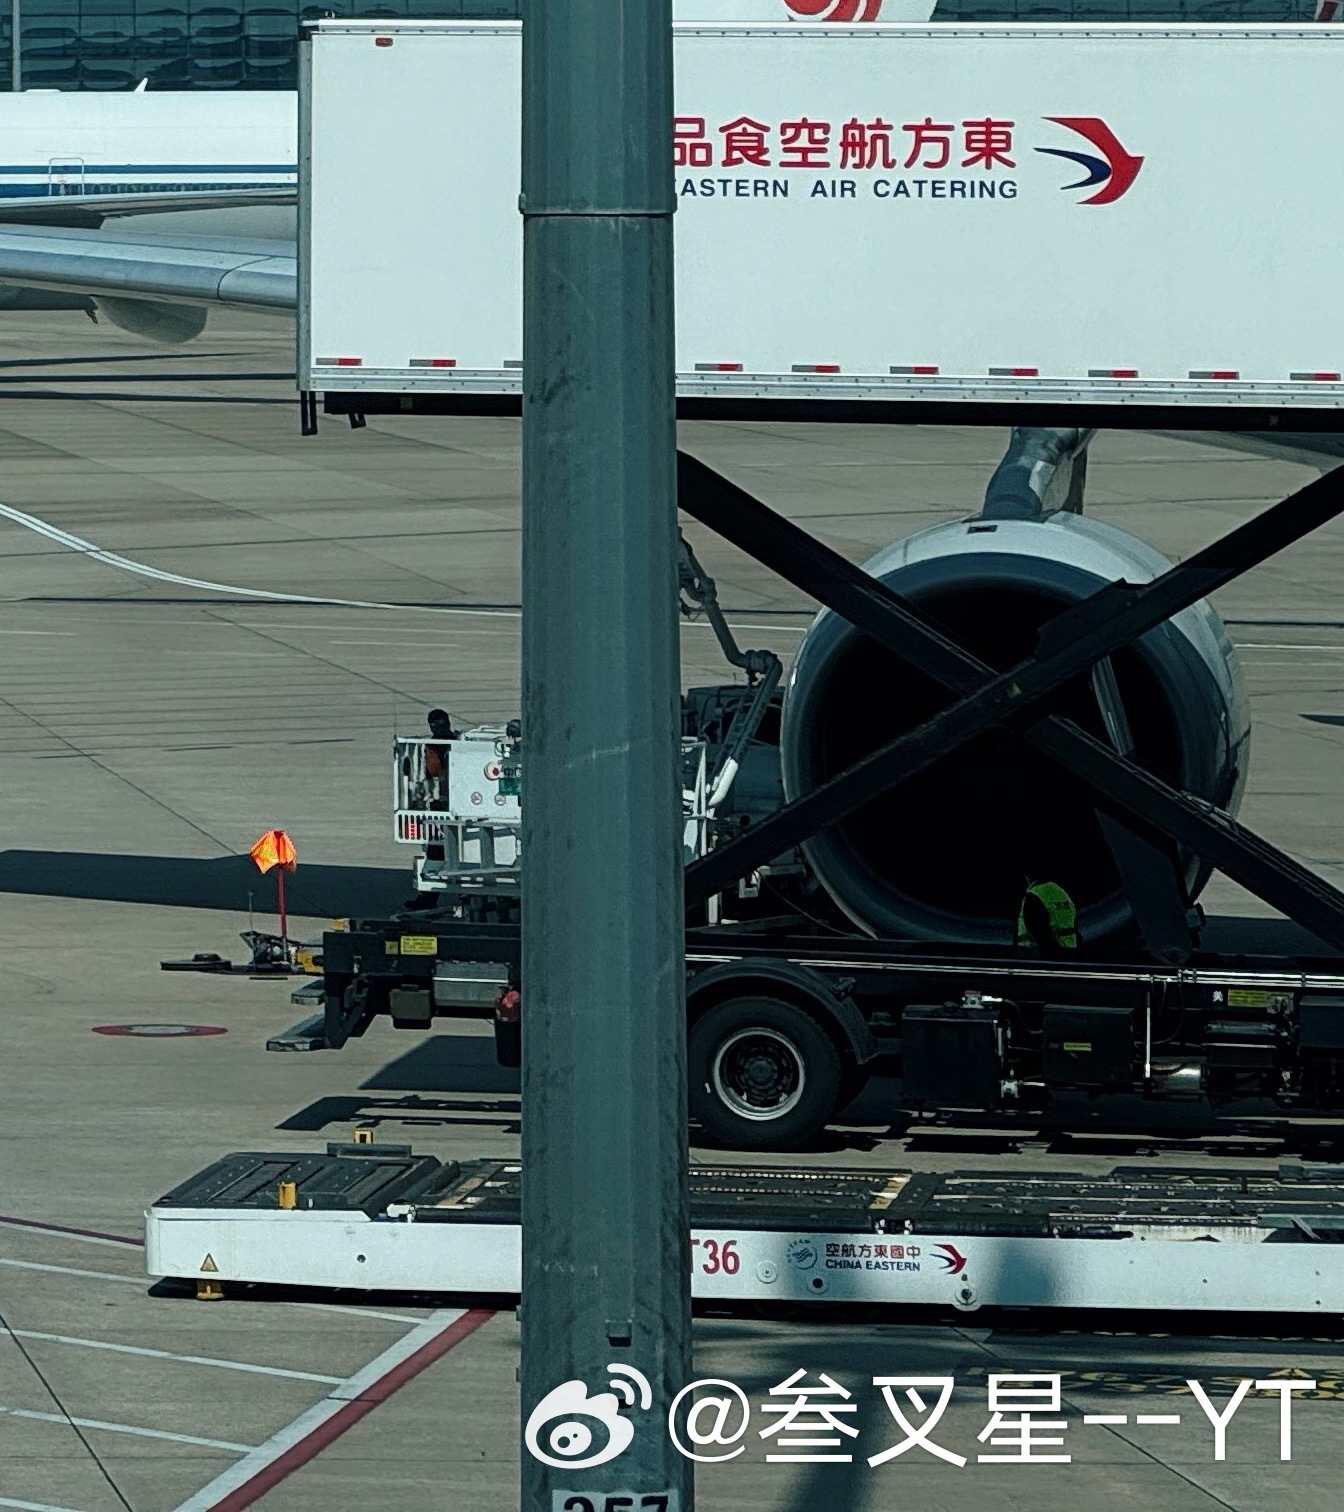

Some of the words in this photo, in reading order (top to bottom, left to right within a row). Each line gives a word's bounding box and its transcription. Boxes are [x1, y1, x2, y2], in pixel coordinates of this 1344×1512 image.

[675, 179, 790, 198] ASTERN
[810, 179, 857, 198] AIR
[873, 179, 1018, 199] CATERING
[825, 1259, 862, 1270] CHINA
[865, 1260, 921, 1272] EASTERN
